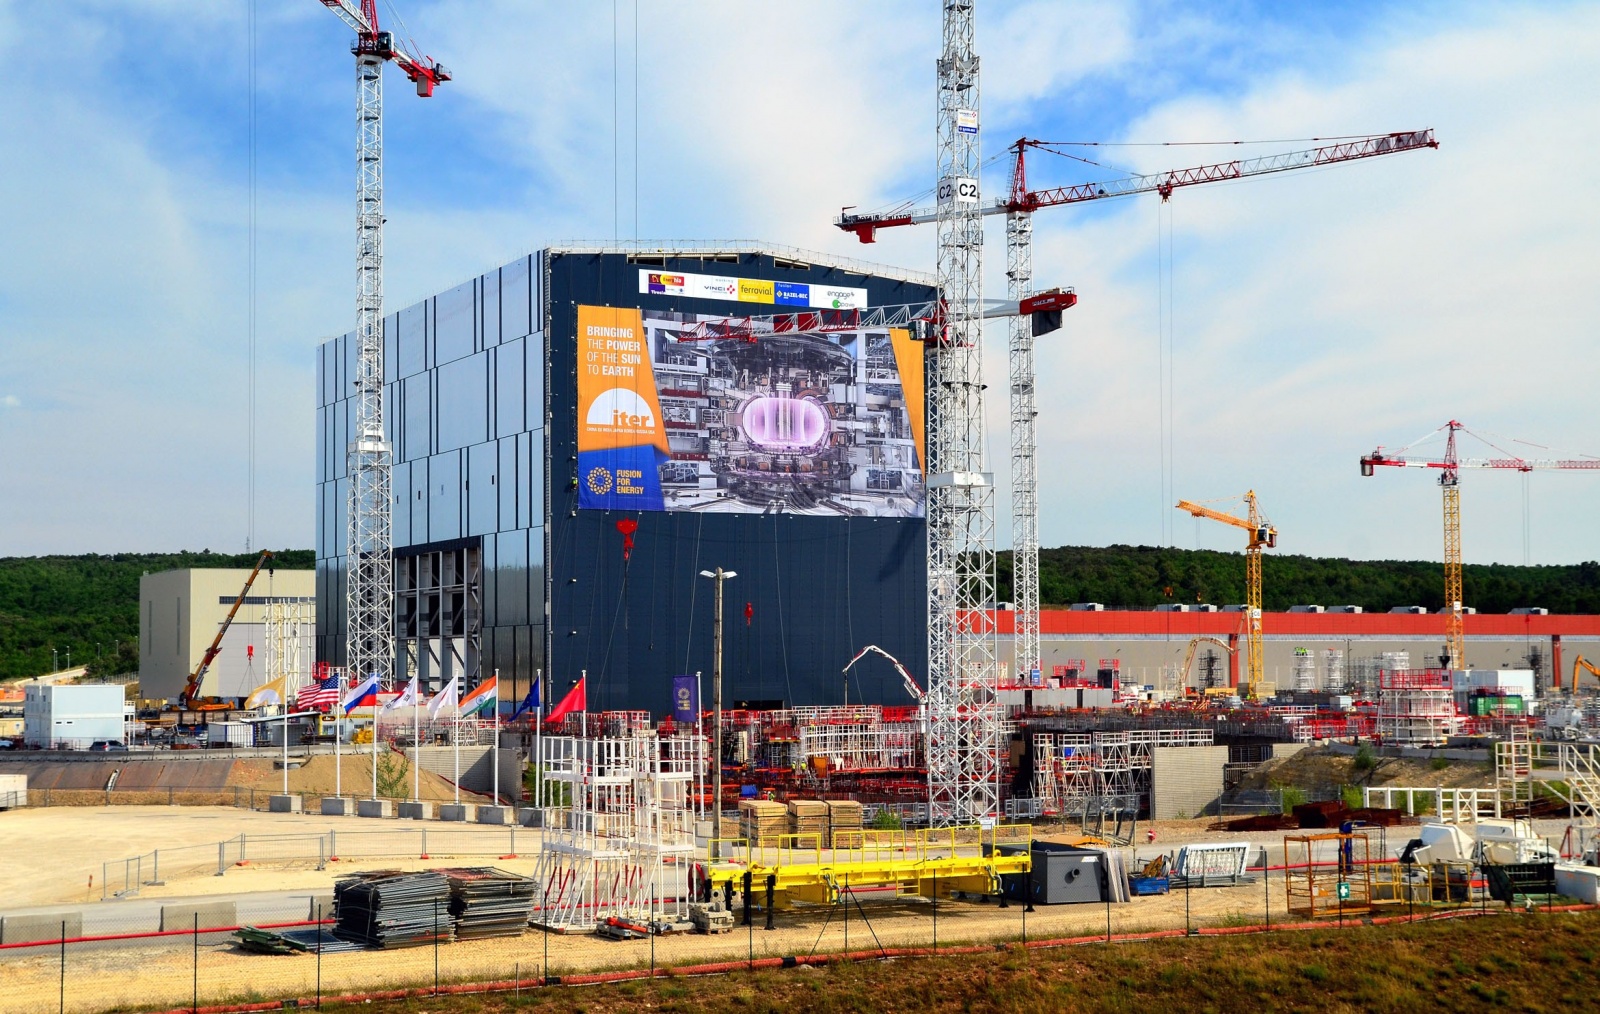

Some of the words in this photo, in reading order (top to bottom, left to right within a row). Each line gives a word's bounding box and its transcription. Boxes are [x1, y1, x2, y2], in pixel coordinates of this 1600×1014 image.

[939, 184, 951, 199] C2
[959, 183, 976, 198] C2
[741, 284, 773, 296] ferrovial
[586, 325, 633, 339] BRINGING
[587, 338, 604, 350] THE
[606, 340, 640, 352] POWER
[587, 351, 599, 362] OF
[601, 352, 619, 364] THE
[621, 353, 641, 364] SUN
[587, 364, 599, 375] TO
[602, 365, 634, 376] EARTH
[613, 409, 650, 427] iter
[616, 469, 642, 478] FUSION
[616, 477, 631, 486] FOR
[616, 485, 644, 495] ENERGY
